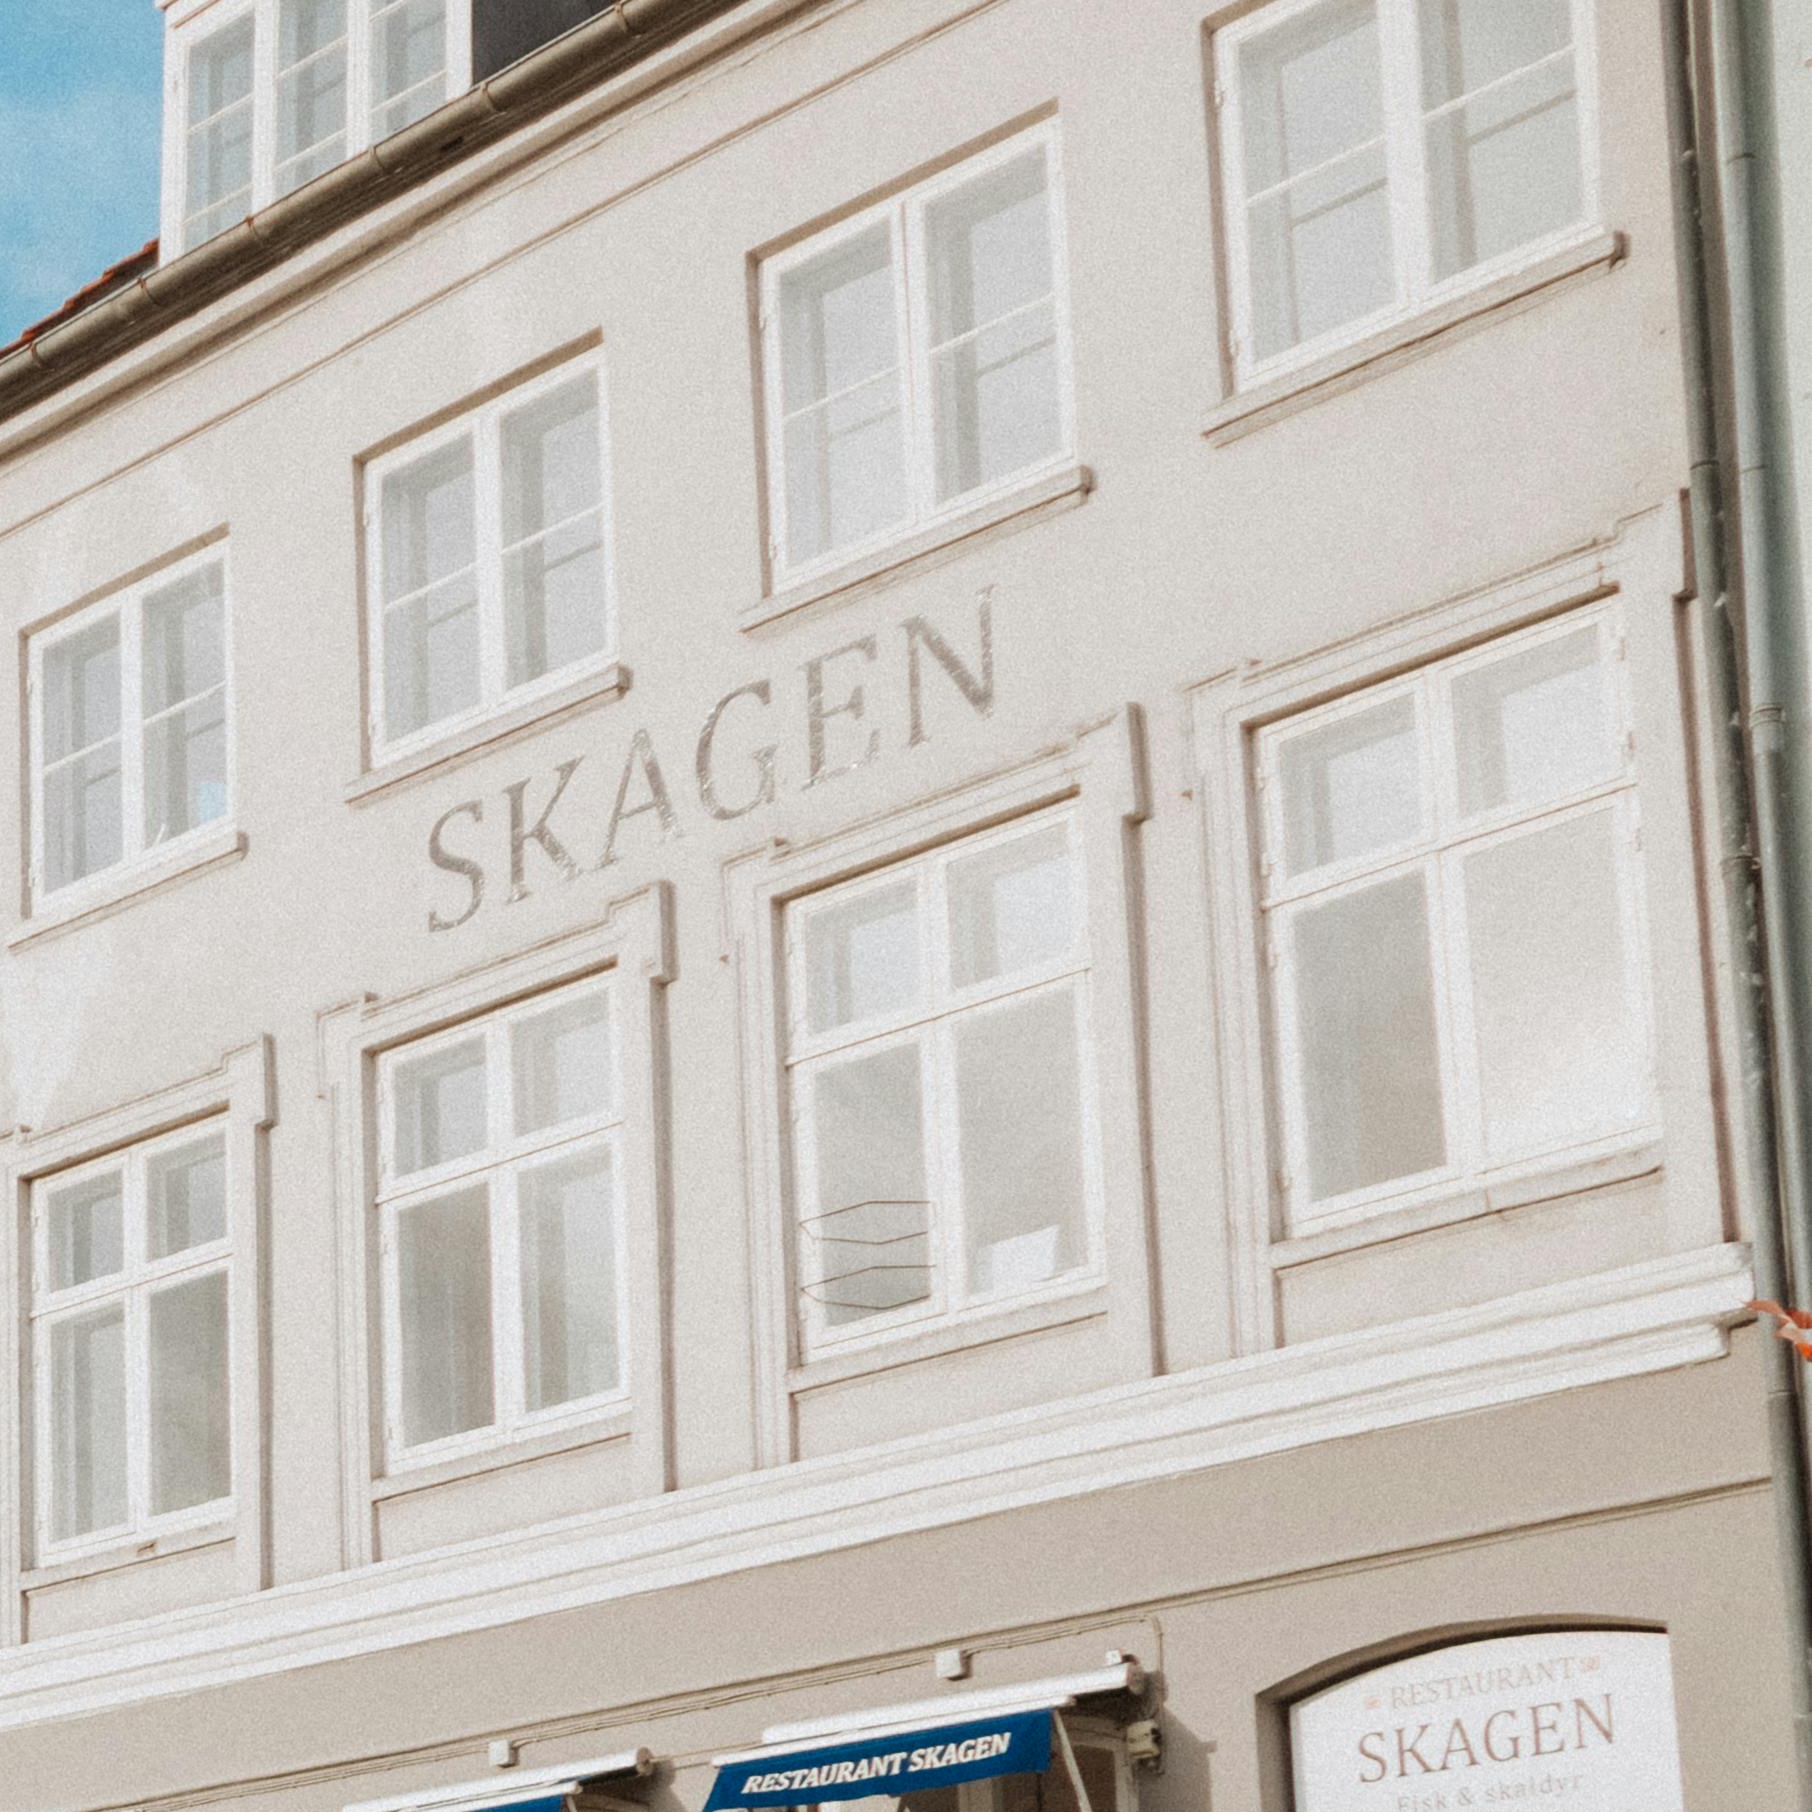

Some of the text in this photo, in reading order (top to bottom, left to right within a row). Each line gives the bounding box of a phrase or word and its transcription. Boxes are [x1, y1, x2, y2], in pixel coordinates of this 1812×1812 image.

[428, 584, 998, 932] SKAGEN
[1391, 1657, 1576, 1708] RESTAURANT
[741, 1732, 1011, 1794] RESTAURANT SKAGEN
[1358, 1693, 1613, 1783] SKAGEN
[1458, 1787, 1474, 1807] &
